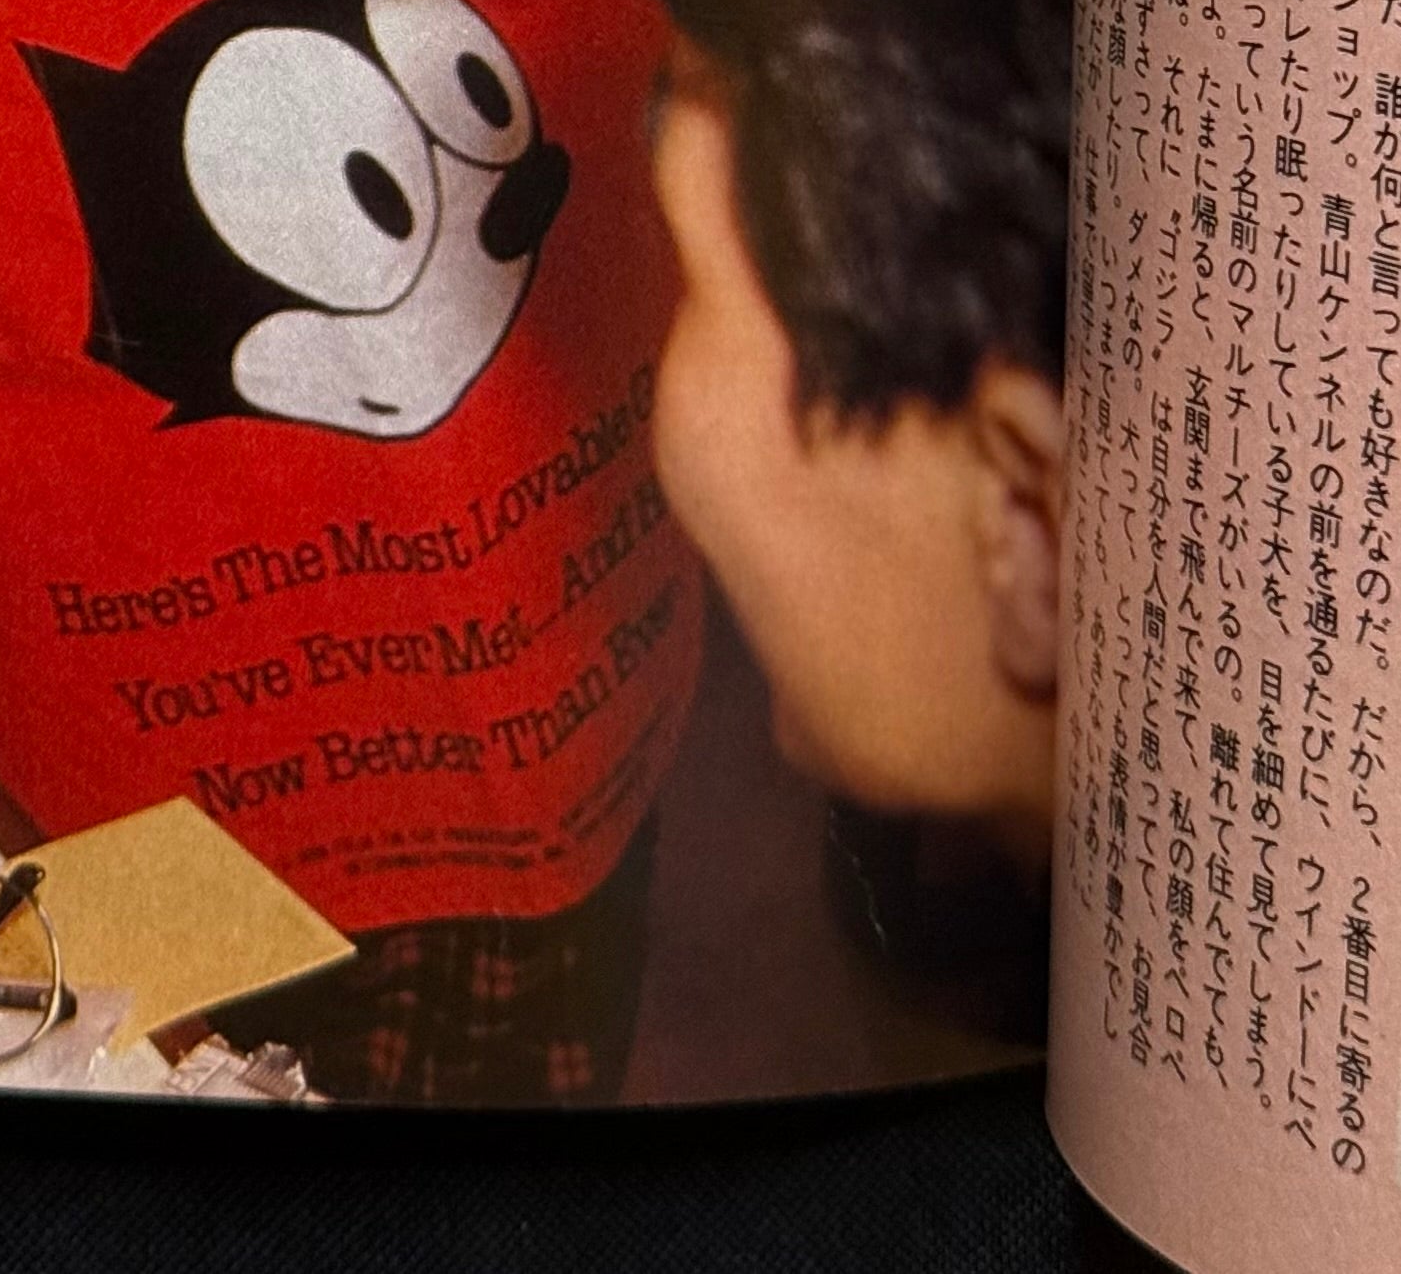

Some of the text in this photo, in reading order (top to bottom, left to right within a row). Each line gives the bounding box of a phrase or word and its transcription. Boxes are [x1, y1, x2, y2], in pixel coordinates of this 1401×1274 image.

[46, 574, 218, 635] Here's
[214, 540, 329, 605] The
[324, 518, 474, 576] Most
[114, 656, 292, 733] You've
[300, 632, 433, 689] Ever
[192, 755, 306, 818] Now
[315, 725, 487, 785] Better
[491, 659, 612, 771] Than
